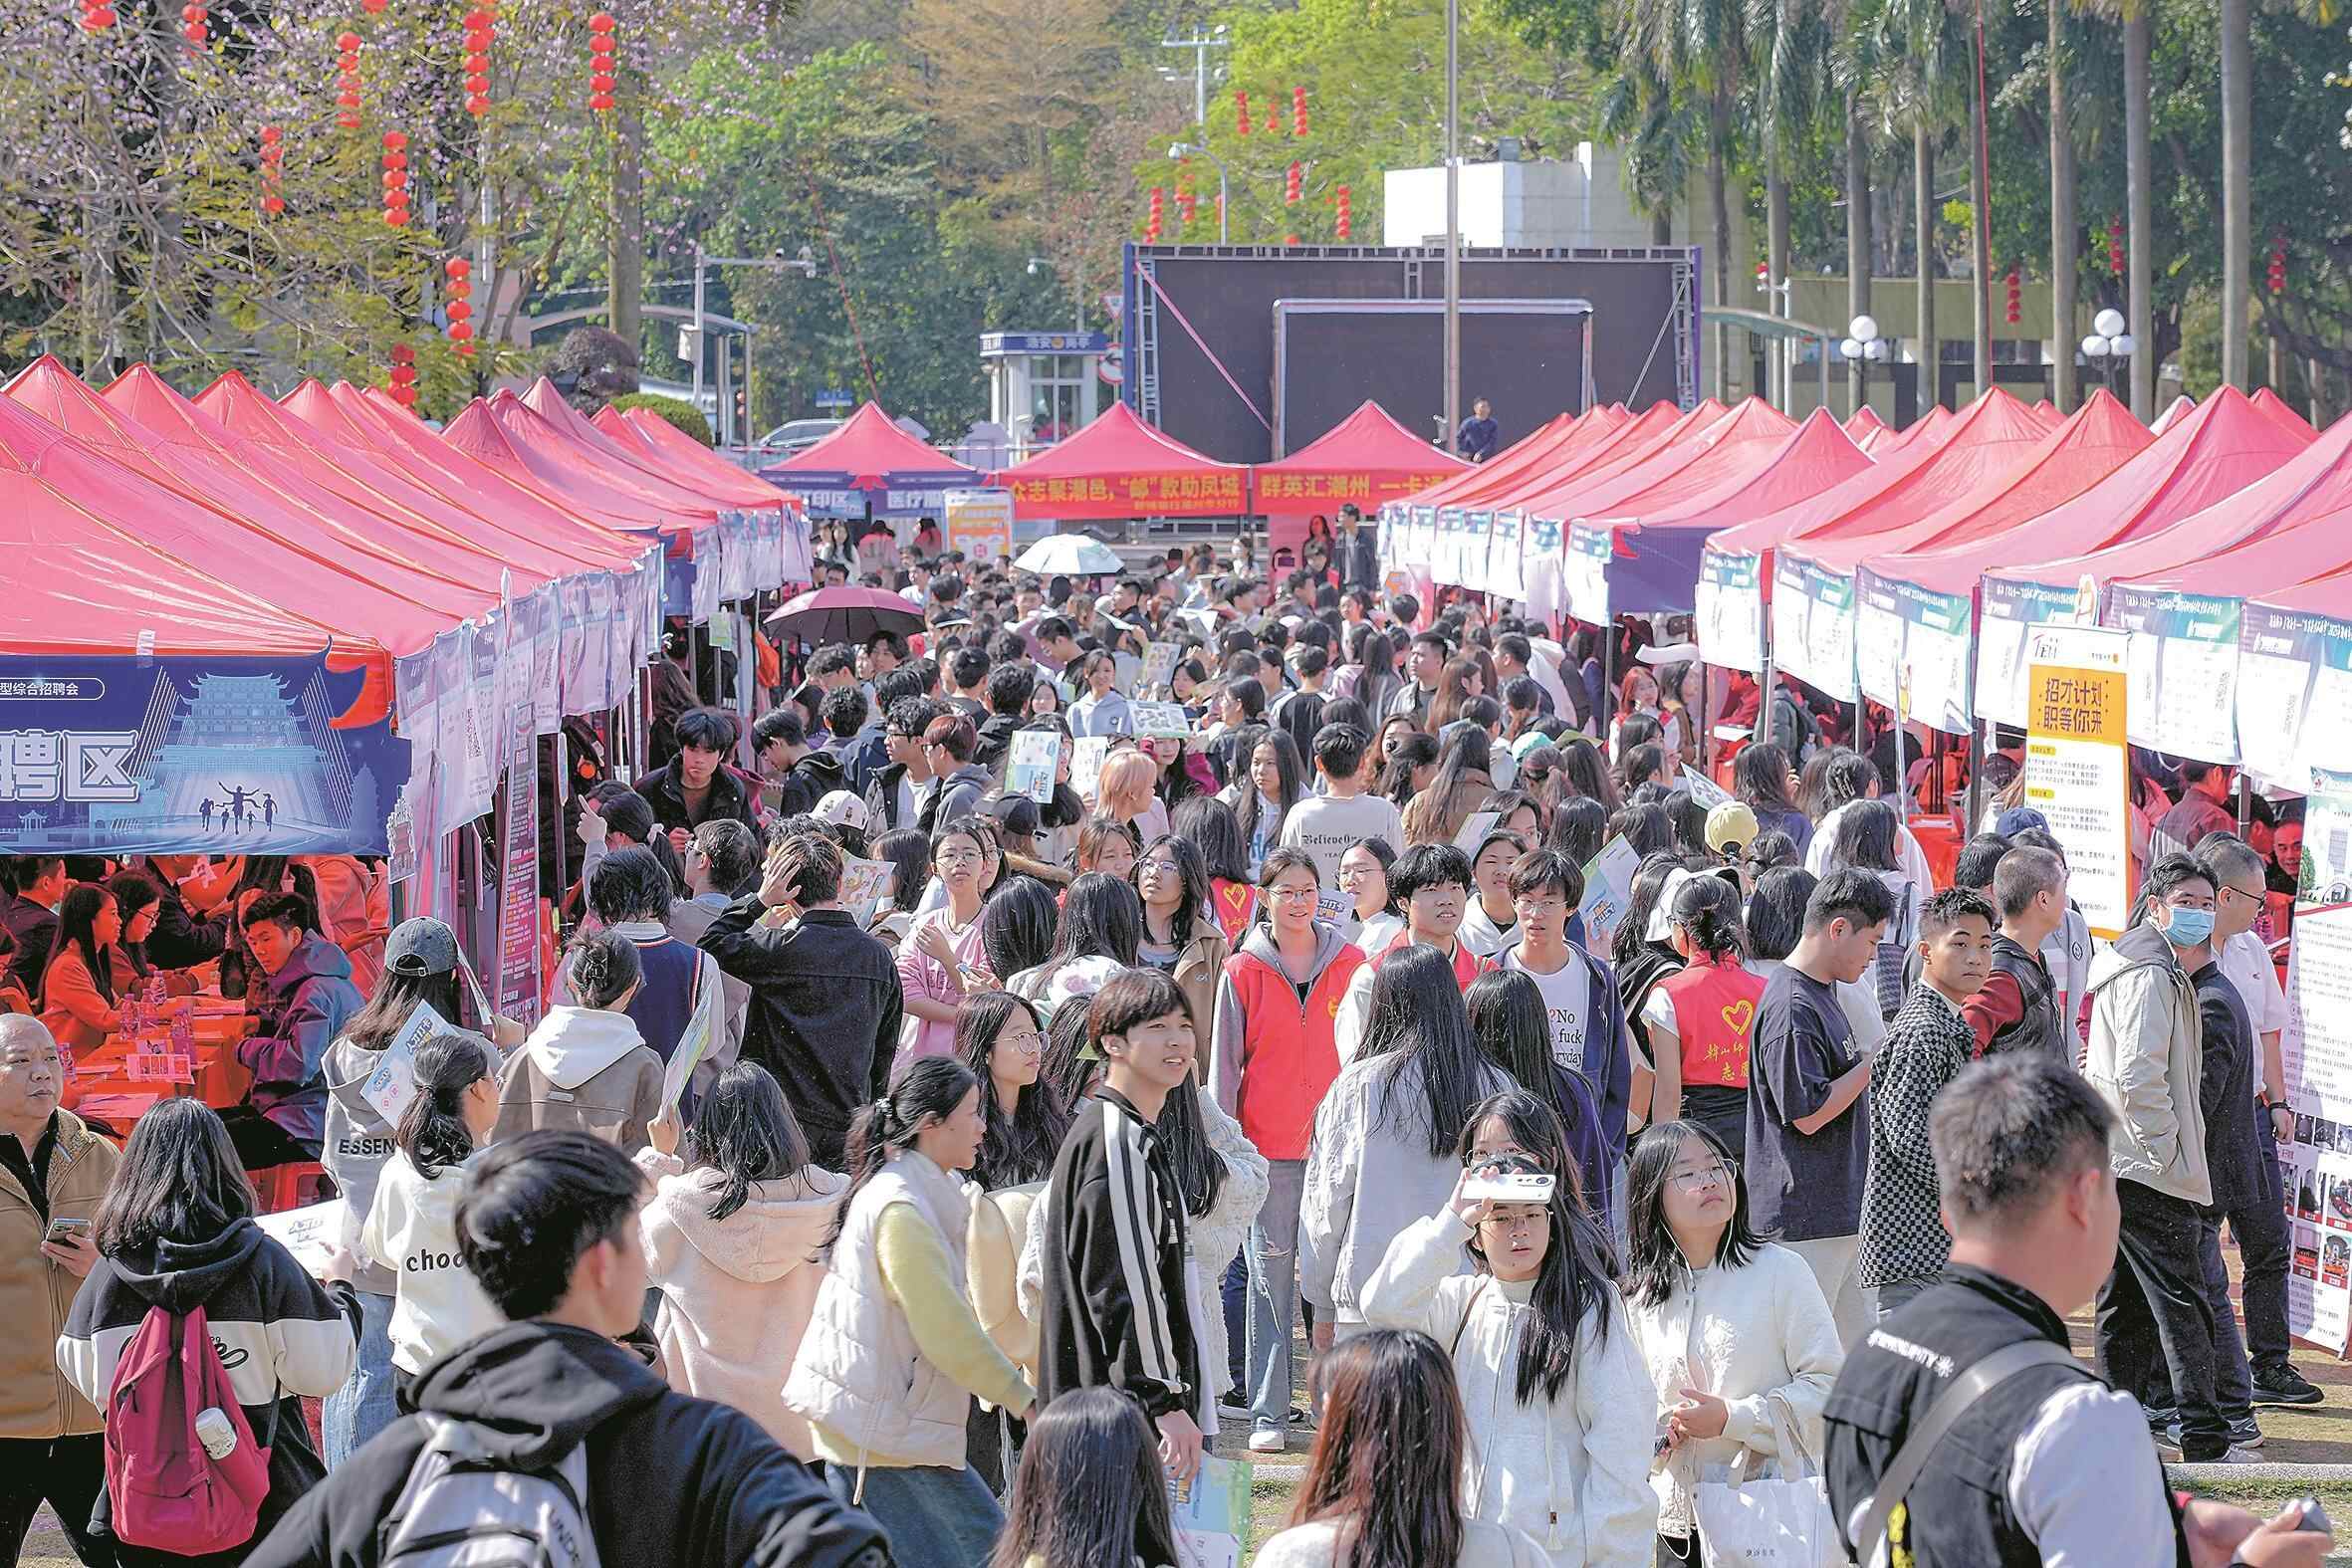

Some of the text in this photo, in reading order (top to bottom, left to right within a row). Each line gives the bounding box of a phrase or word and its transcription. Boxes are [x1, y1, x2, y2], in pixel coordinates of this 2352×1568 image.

[1261, 474, 1370, 497] 群英汇潮州
[2044, 678, 2102, 707] 招才计划
[2042, 705, 2103, 735] 职等你来
[1559, 1028, 1581, 1043] fuck
